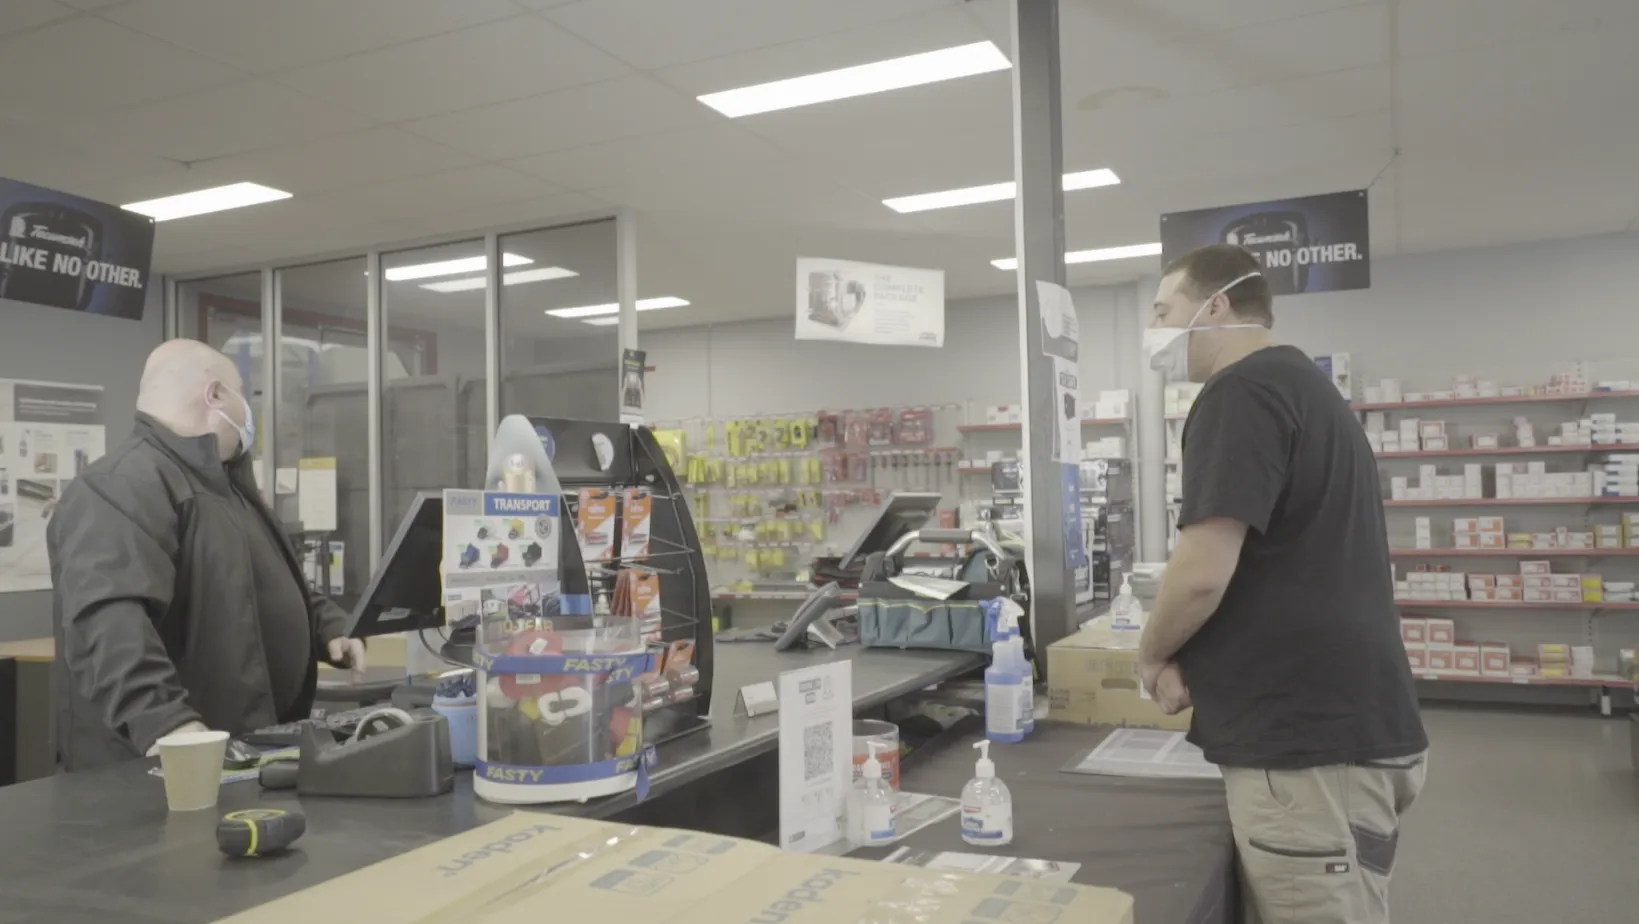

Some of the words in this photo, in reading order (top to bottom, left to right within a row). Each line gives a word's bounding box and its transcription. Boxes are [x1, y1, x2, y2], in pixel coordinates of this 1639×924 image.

[0, 242, 48, 270] LIKE
[53, 252, 81, 277] NO
[86, 260, 143, 289] OTHER.
[1266, 250, 1291, 268] NO
[1297, 243, 1363, 266] OTHER.
[493, 498, 551, 511] TRANSPORT
[563, 657, 627, 671] FASTY
[486, 766, 543, 782] FASTY
[436, 825, 563, 877] koden
